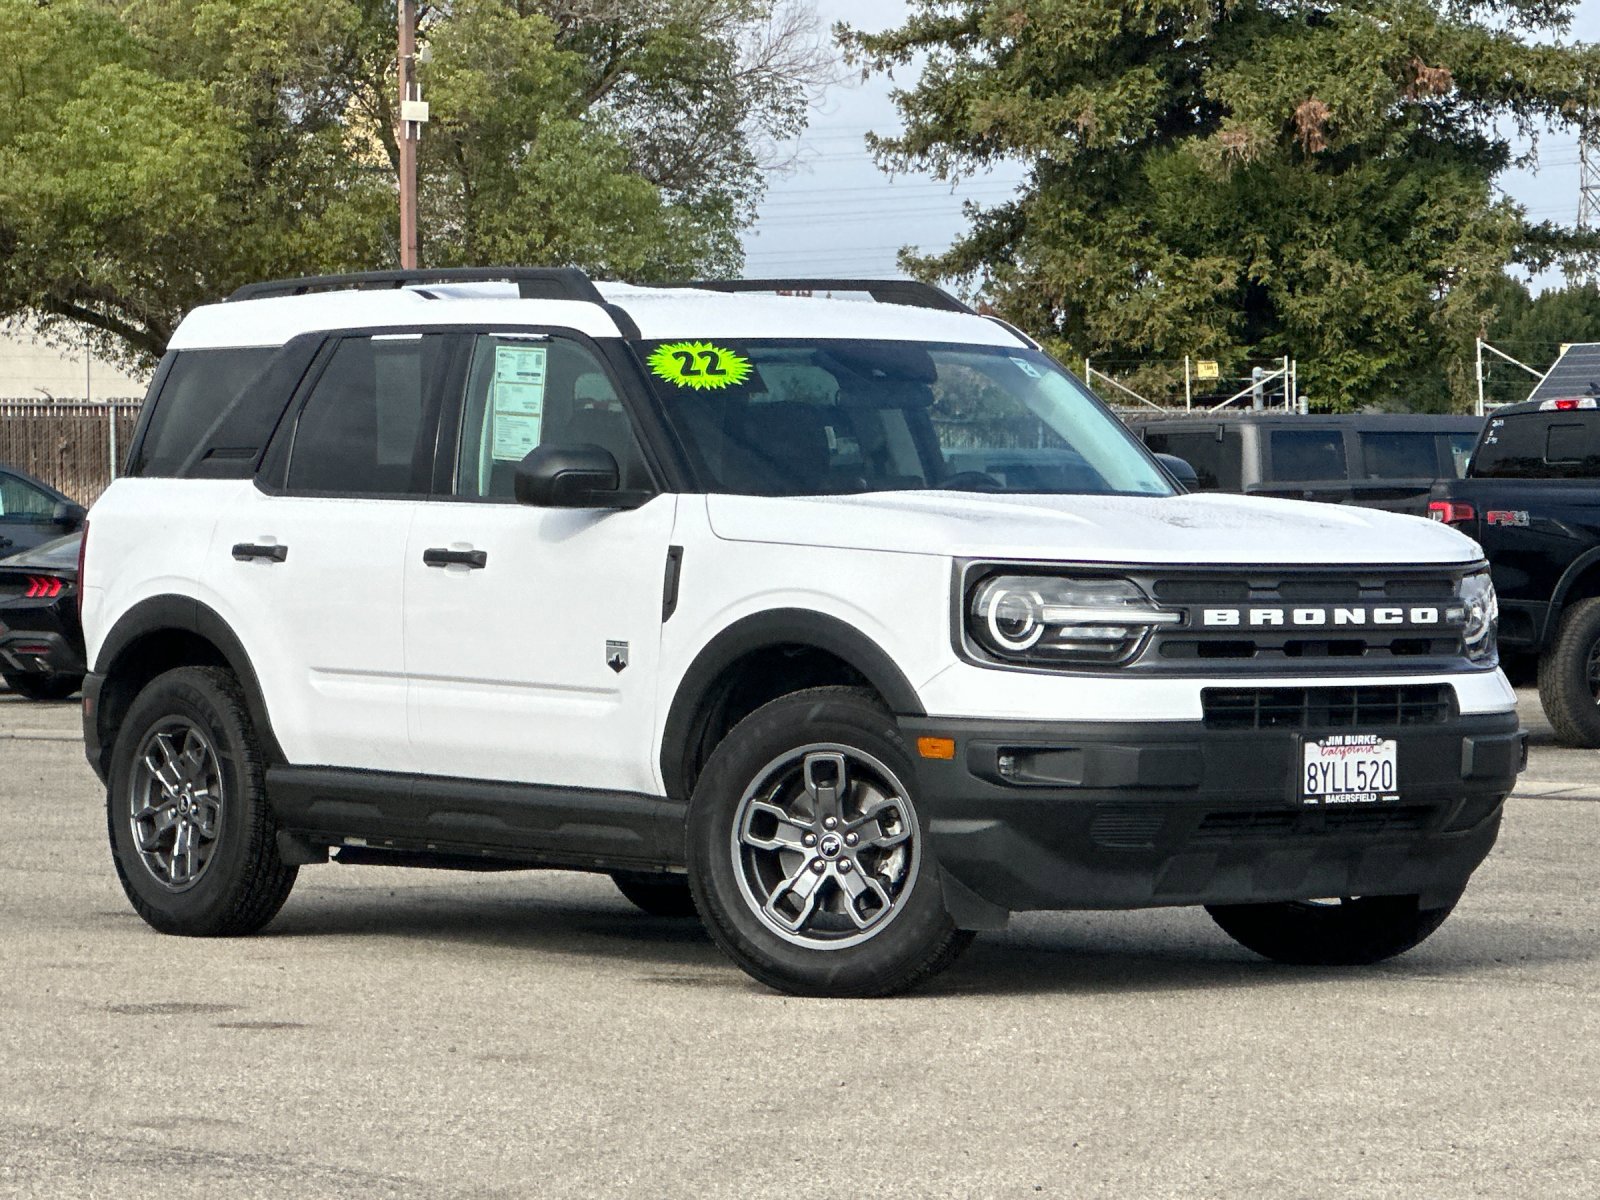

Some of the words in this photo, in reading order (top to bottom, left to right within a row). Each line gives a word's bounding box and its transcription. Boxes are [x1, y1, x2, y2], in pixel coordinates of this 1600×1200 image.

[672, 350, 727, 376] 22
[1203, 607, 1439, 626] BRONCO
[1326, 736, 1343, 746] JIM
[1344, 735, 1377, 745] BURKE
[1320, 745, 1381, 760] California
[1307, 760, 1392, 793] 8YLL520
[1325, 793, 1377, 803] BAKERSFIELD
